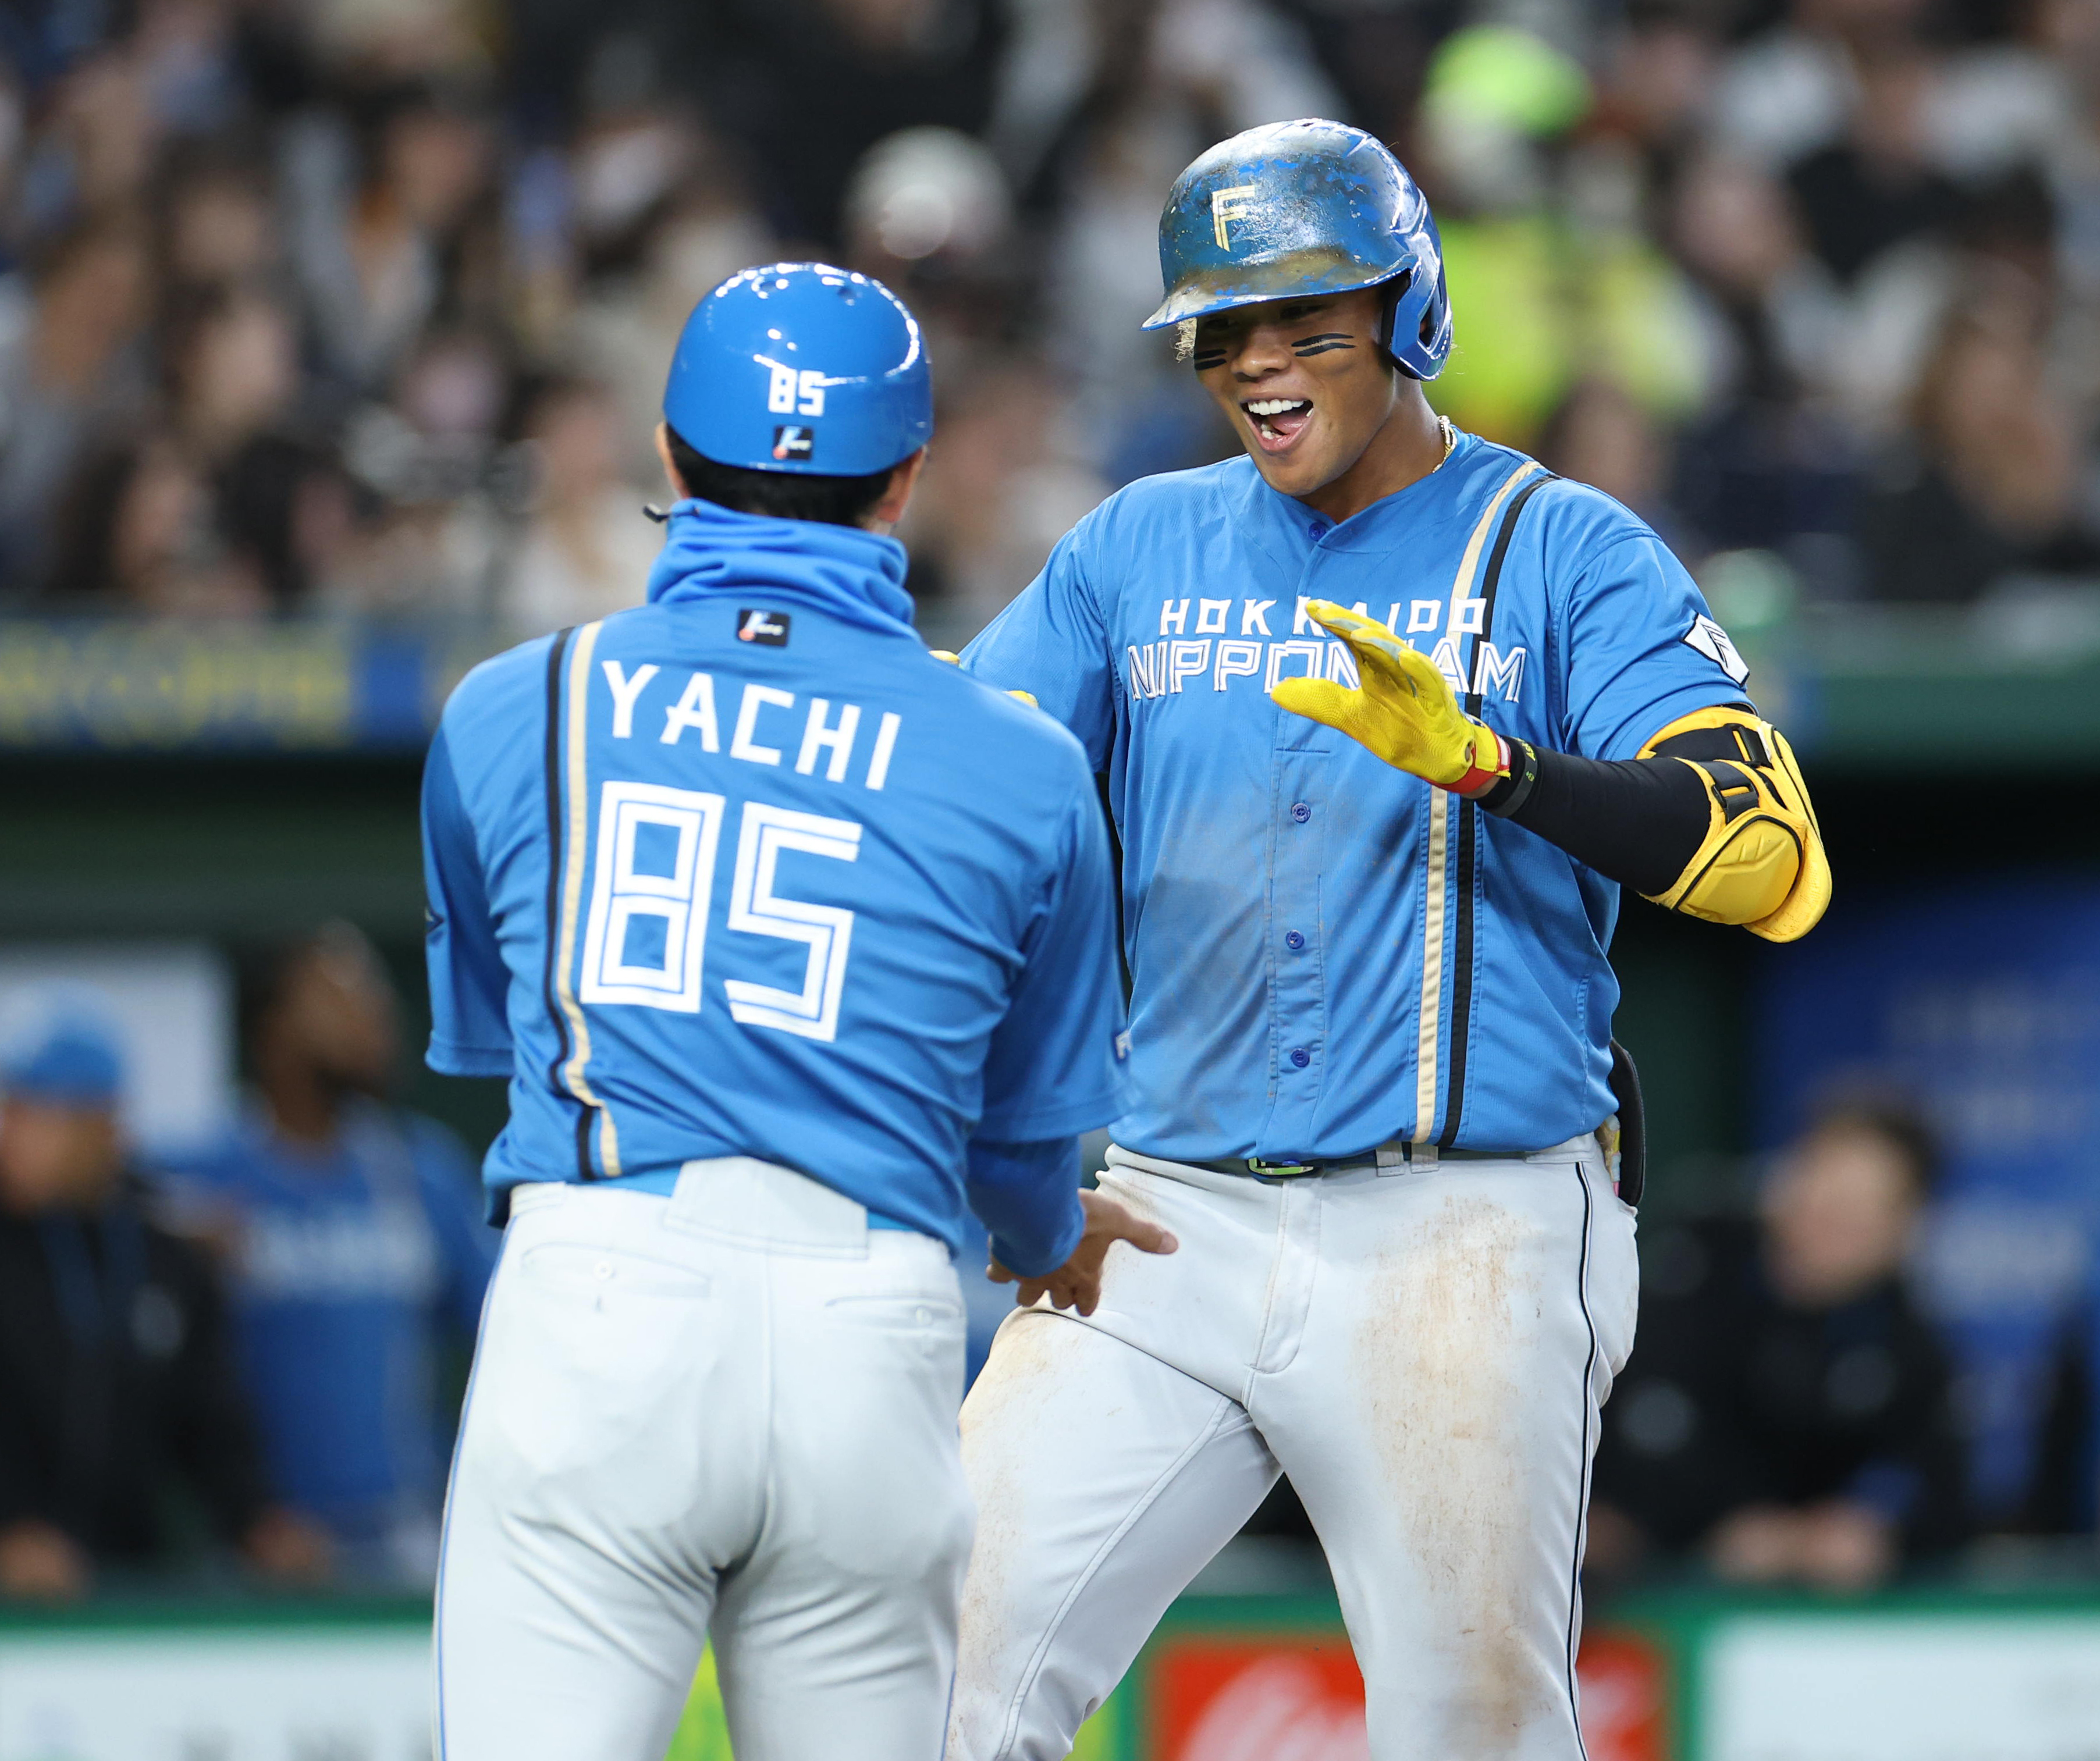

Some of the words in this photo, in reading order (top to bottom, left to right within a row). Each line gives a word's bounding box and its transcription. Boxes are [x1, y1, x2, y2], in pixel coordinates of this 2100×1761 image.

[1212, 186, 1255, 252] F
[768, 368, 825, 417] 85
[1128, 638, 1526, 702] NIPPONAM
[601, 661, 901, 791] YACHI
[580, 781, 863, 1043] 85
